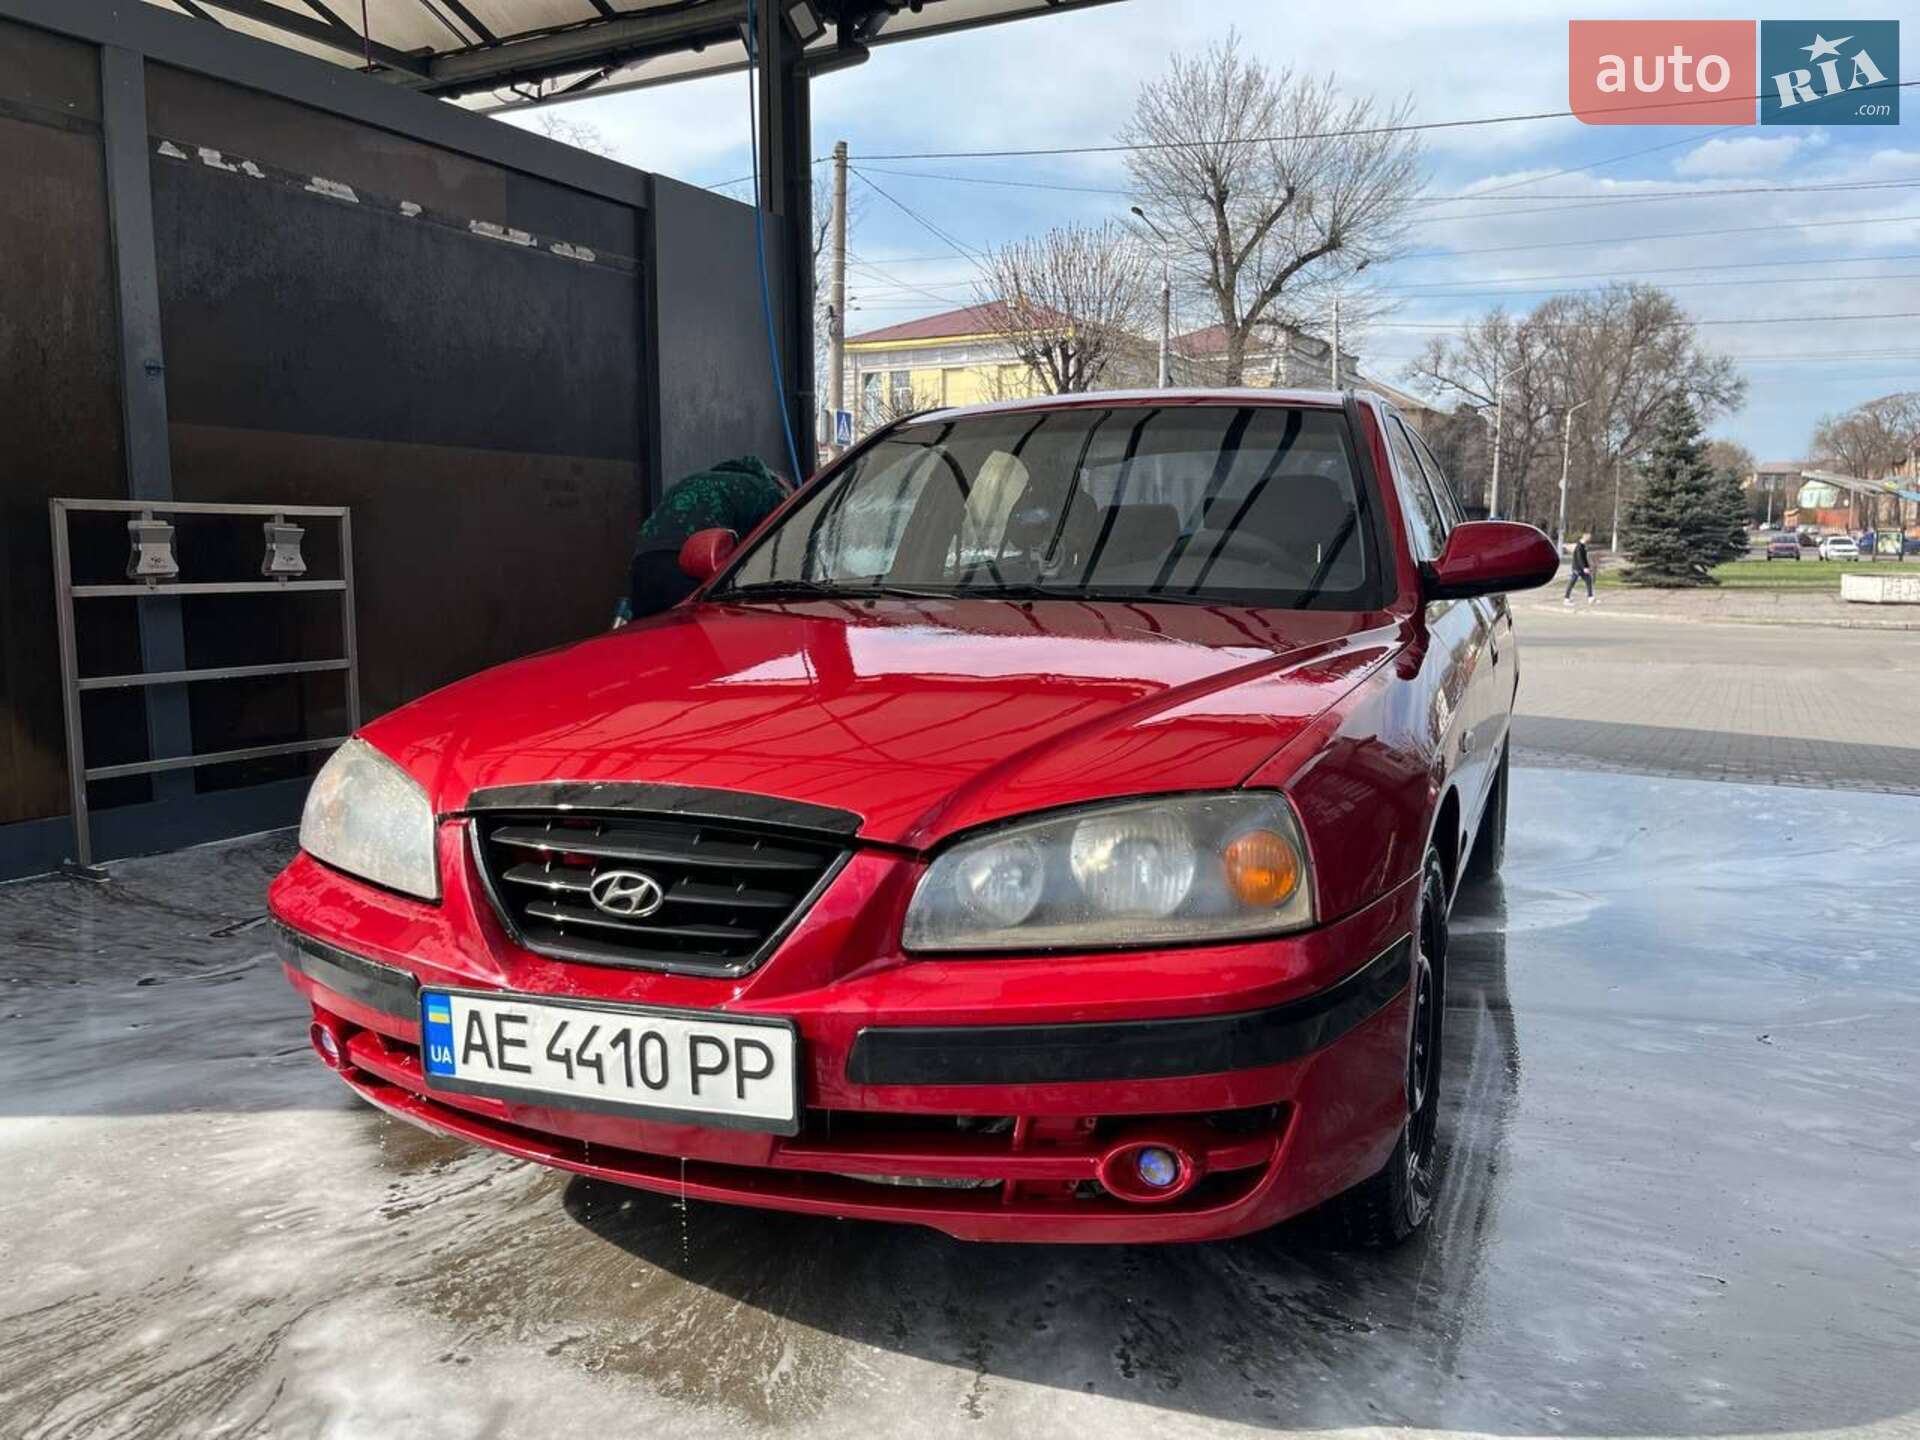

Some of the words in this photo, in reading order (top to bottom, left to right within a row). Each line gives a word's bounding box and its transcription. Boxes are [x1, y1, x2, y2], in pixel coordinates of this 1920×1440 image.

[431, 1045, 453, 1065] UA
[462, 1010, 532, 1073] AE
[546, 1020, 669, 1090] 4410
[689, 1034, 774, 1099] PP
